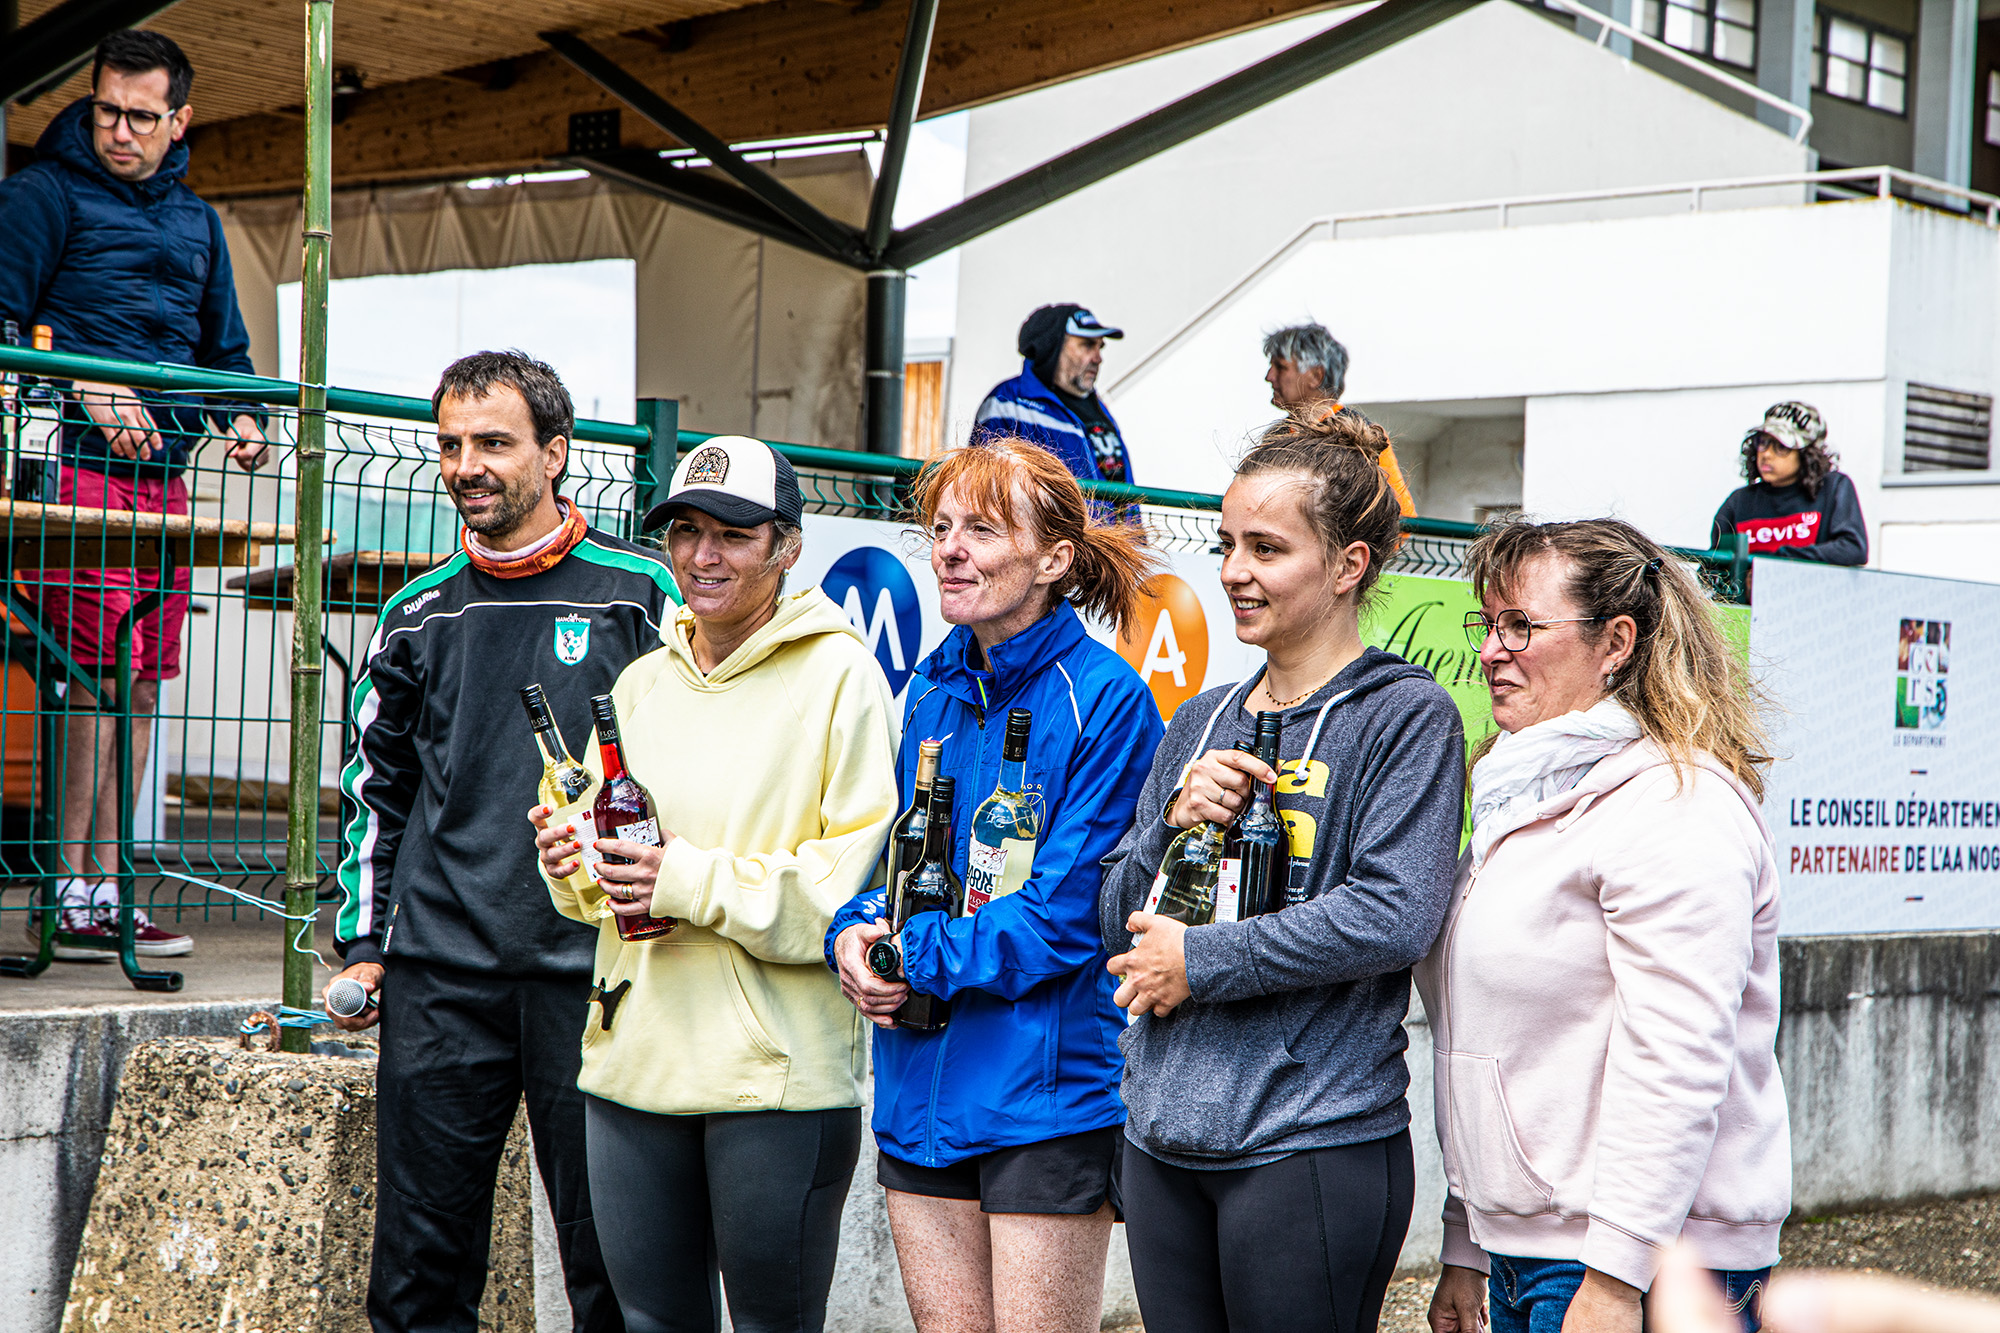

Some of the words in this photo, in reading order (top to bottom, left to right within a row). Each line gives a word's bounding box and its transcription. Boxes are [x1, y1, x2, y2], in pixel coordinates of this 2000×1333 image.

[402, 589, 441, 616] DUARIG
[1140, 608, 1187, 687] A
[1791, 798, 1812, 827] LE
[1817, 799, 1890, 827] CONSEIL
[1791, 845, 1900, 874] PARTENAIRE
[1905, 845, 1926, 872] DE
[1931, 845, 1964, 872] L'AA
